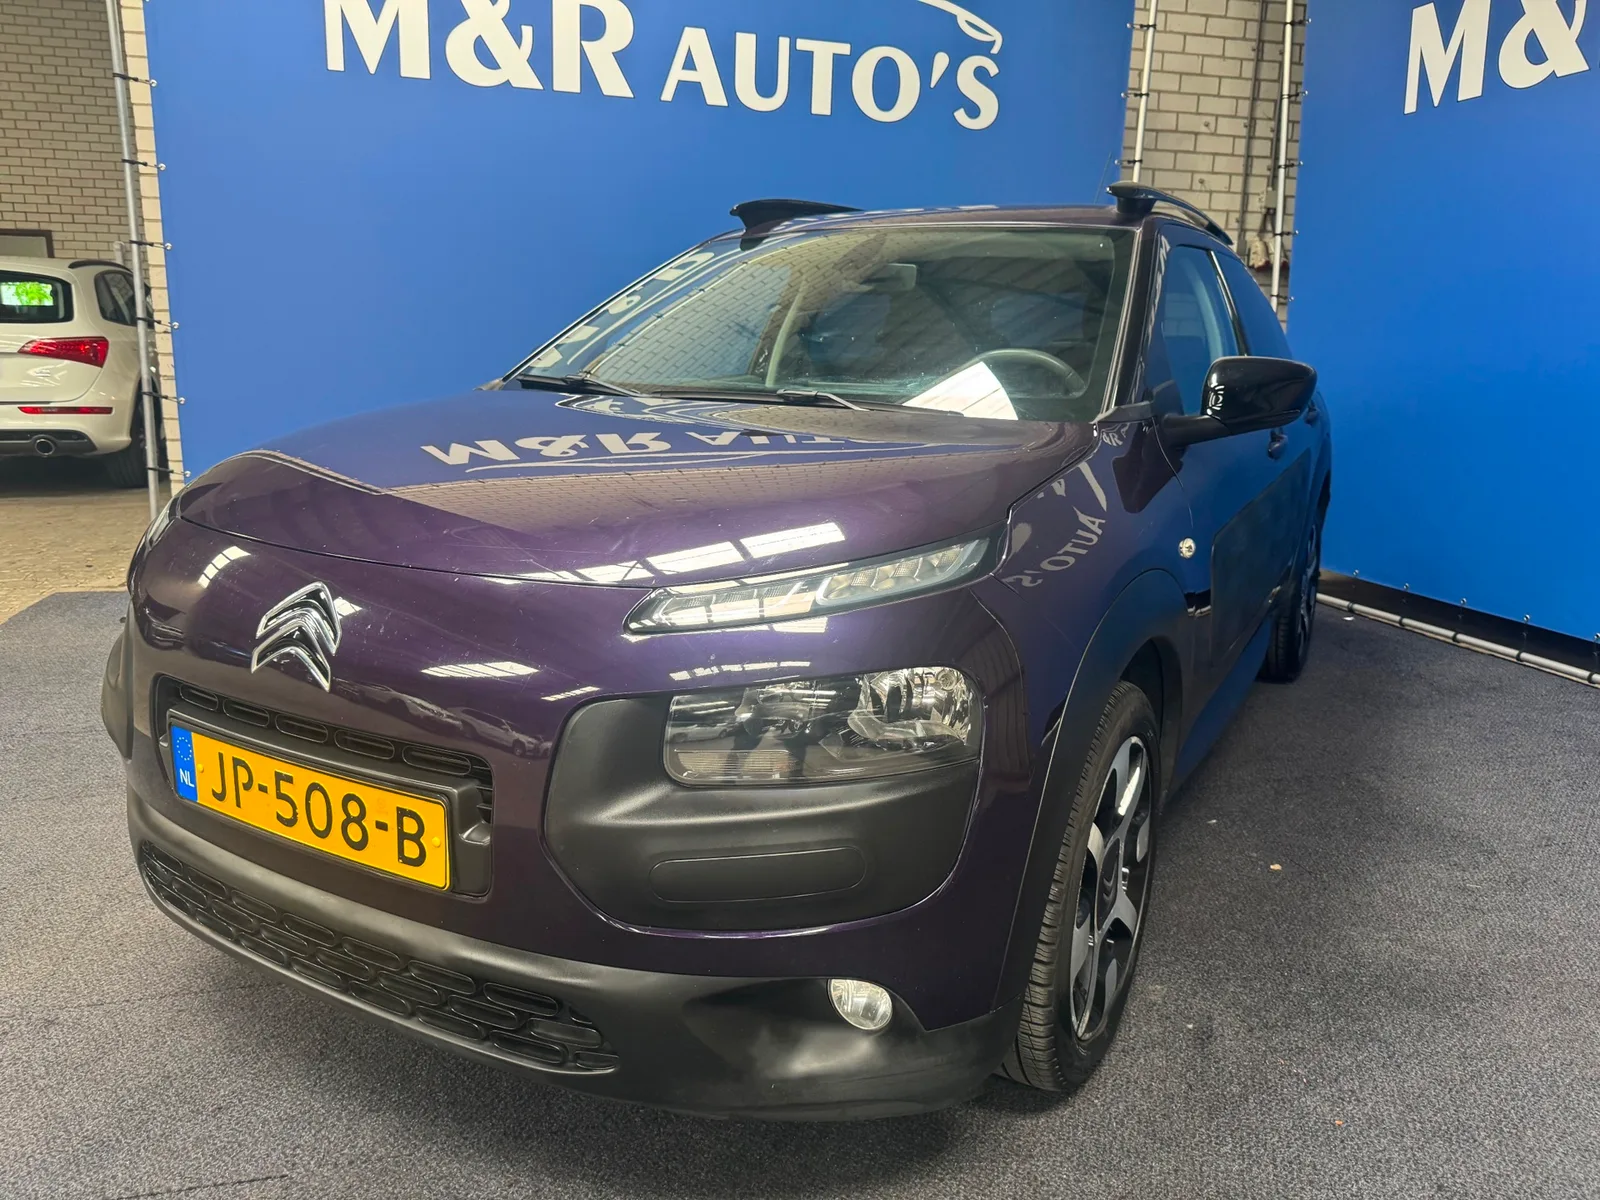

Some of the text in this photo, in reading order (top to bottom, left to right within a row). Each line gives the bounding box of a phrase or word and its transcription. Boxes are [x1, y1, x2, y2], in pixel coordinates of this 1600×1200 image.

[323, 0, 1000, 130] M&R AUTO'S
[179, 767, 195, 788] NL
[211, 751, 427, 867] JP-508-B
